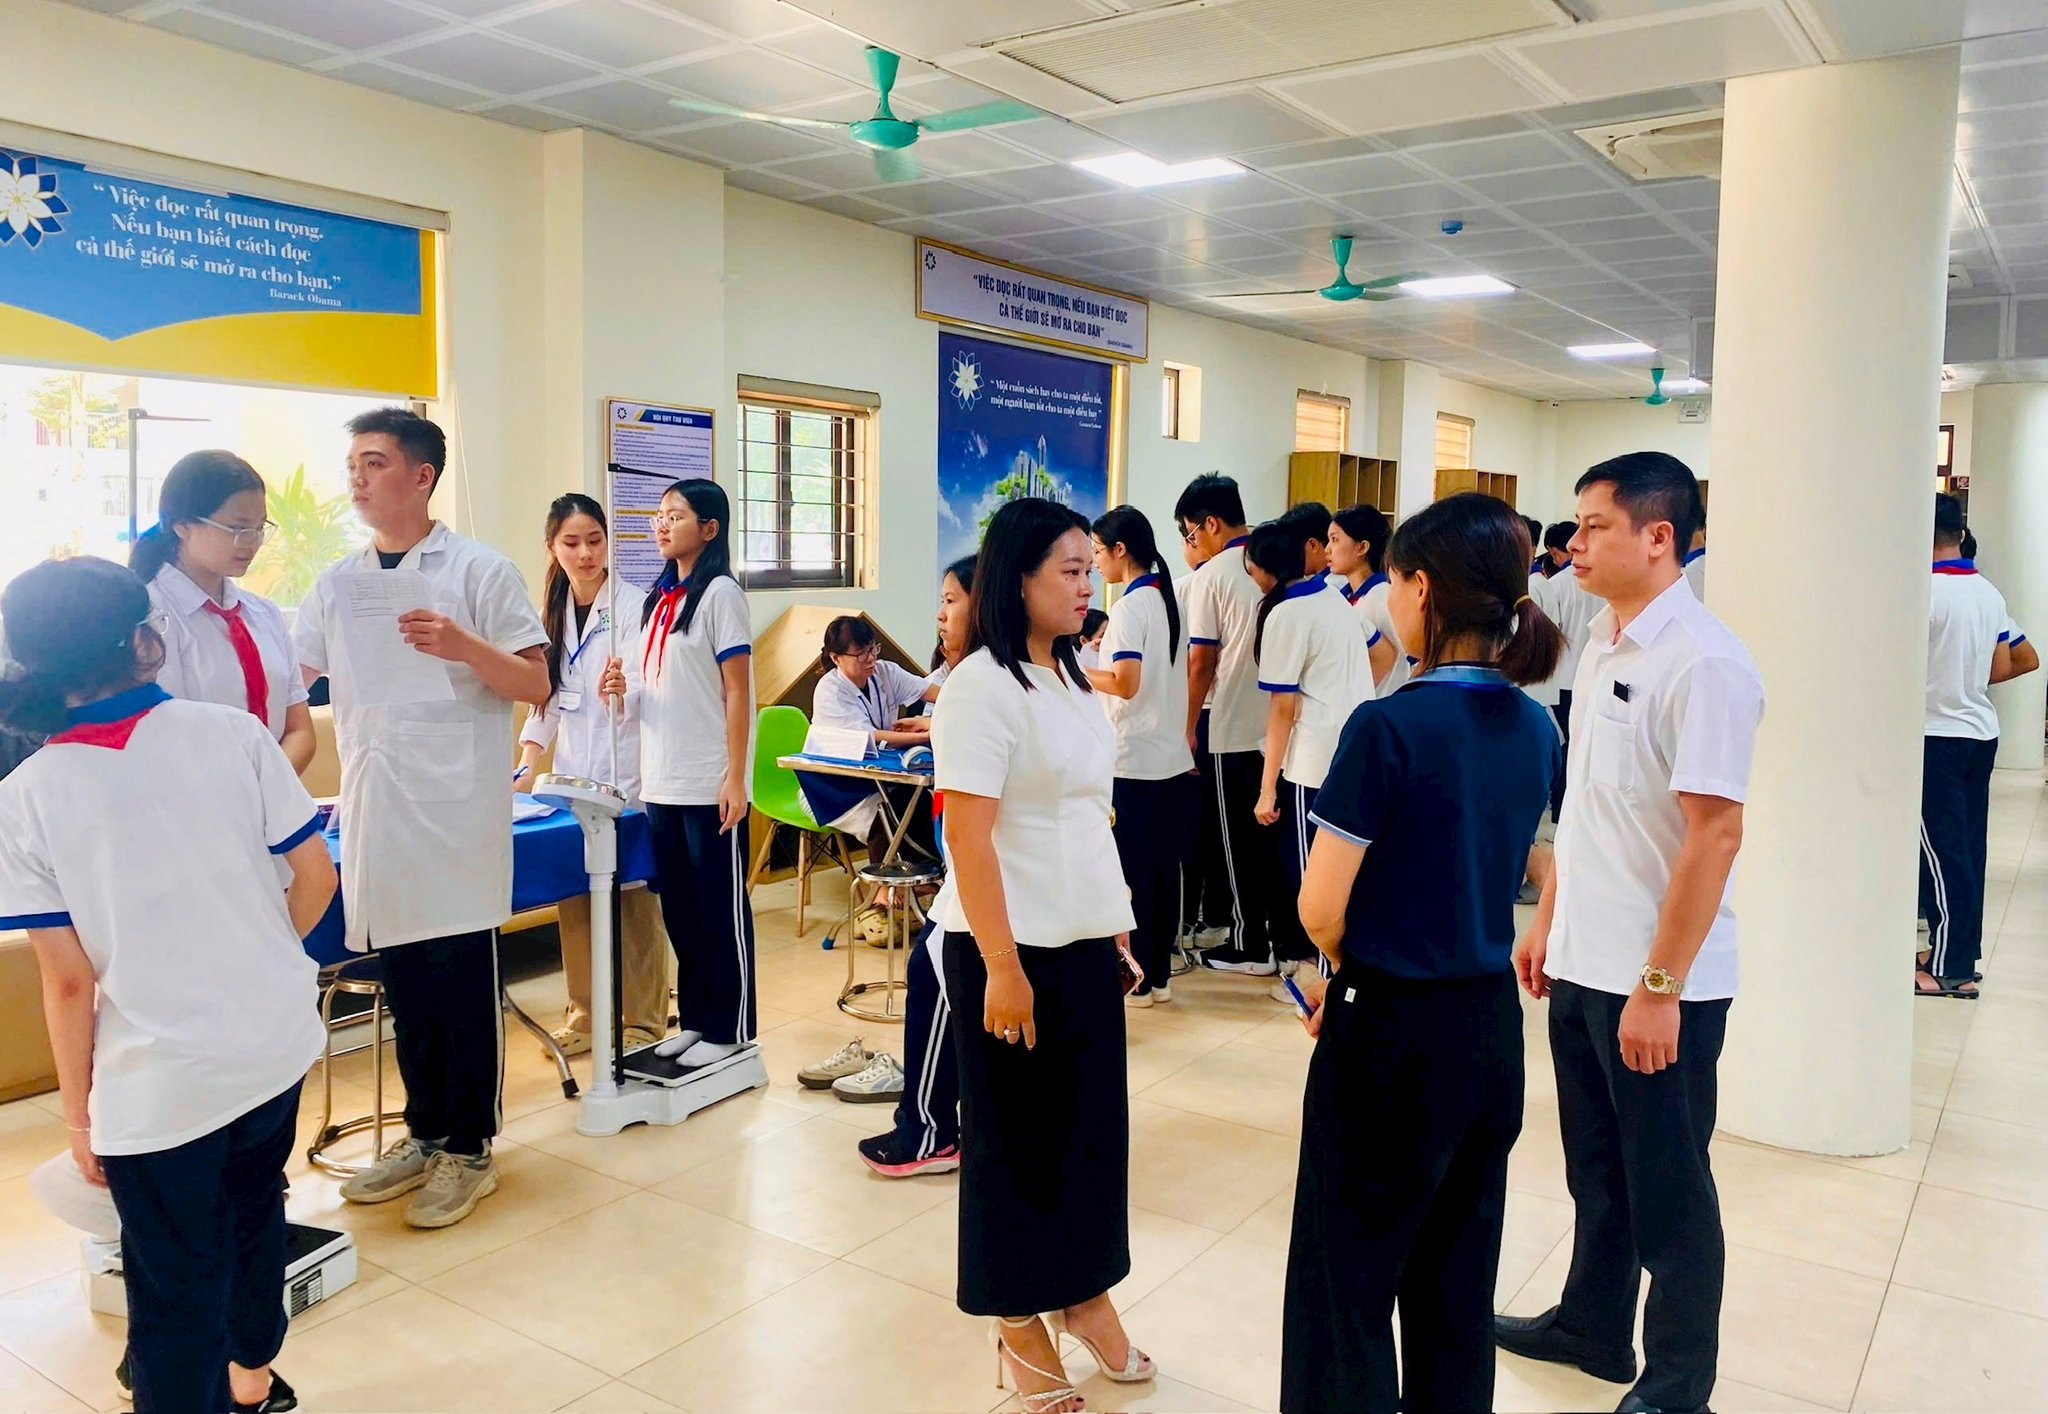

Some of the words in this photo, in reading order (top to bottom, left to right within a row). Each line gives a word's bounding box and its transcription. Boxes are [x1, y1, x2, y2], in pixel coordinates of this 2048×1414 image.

[109, 184, 150, 212] Việc
[194, 199, 220, 221] rất
[224, 211, 270, 230] quan
[275, 219, 324, 242] trọng.
[111, 211, 151, 236] Nếu
[156, 220, 193, 245] bạn
[197, 227, 231, 249] biết
[235, 236, 277, 257] cách
[280, 242, 312, 266] đọc
[75, 235, 99, 256] cả
[104, 237, 136, 261] thế
[140, 245, 176, 269] giới
[180, 254, 200, 270] sẽ
[204, 258, 236, 276] mở
[239, 265, 257, 280] ra
[261, 266, 294, 285] cho
[270, 288, 305, 302] Barack
[307, 293, 342, 307] Obama
[1027, 286, 1046, 306] QUAN
[1086, 300, 1100, 320] BẠN
[1010, 303, 1024, 321] THẾ
[1062, 316, 1072, 333] RA
[1073, 319, 1087, 336] CHO
